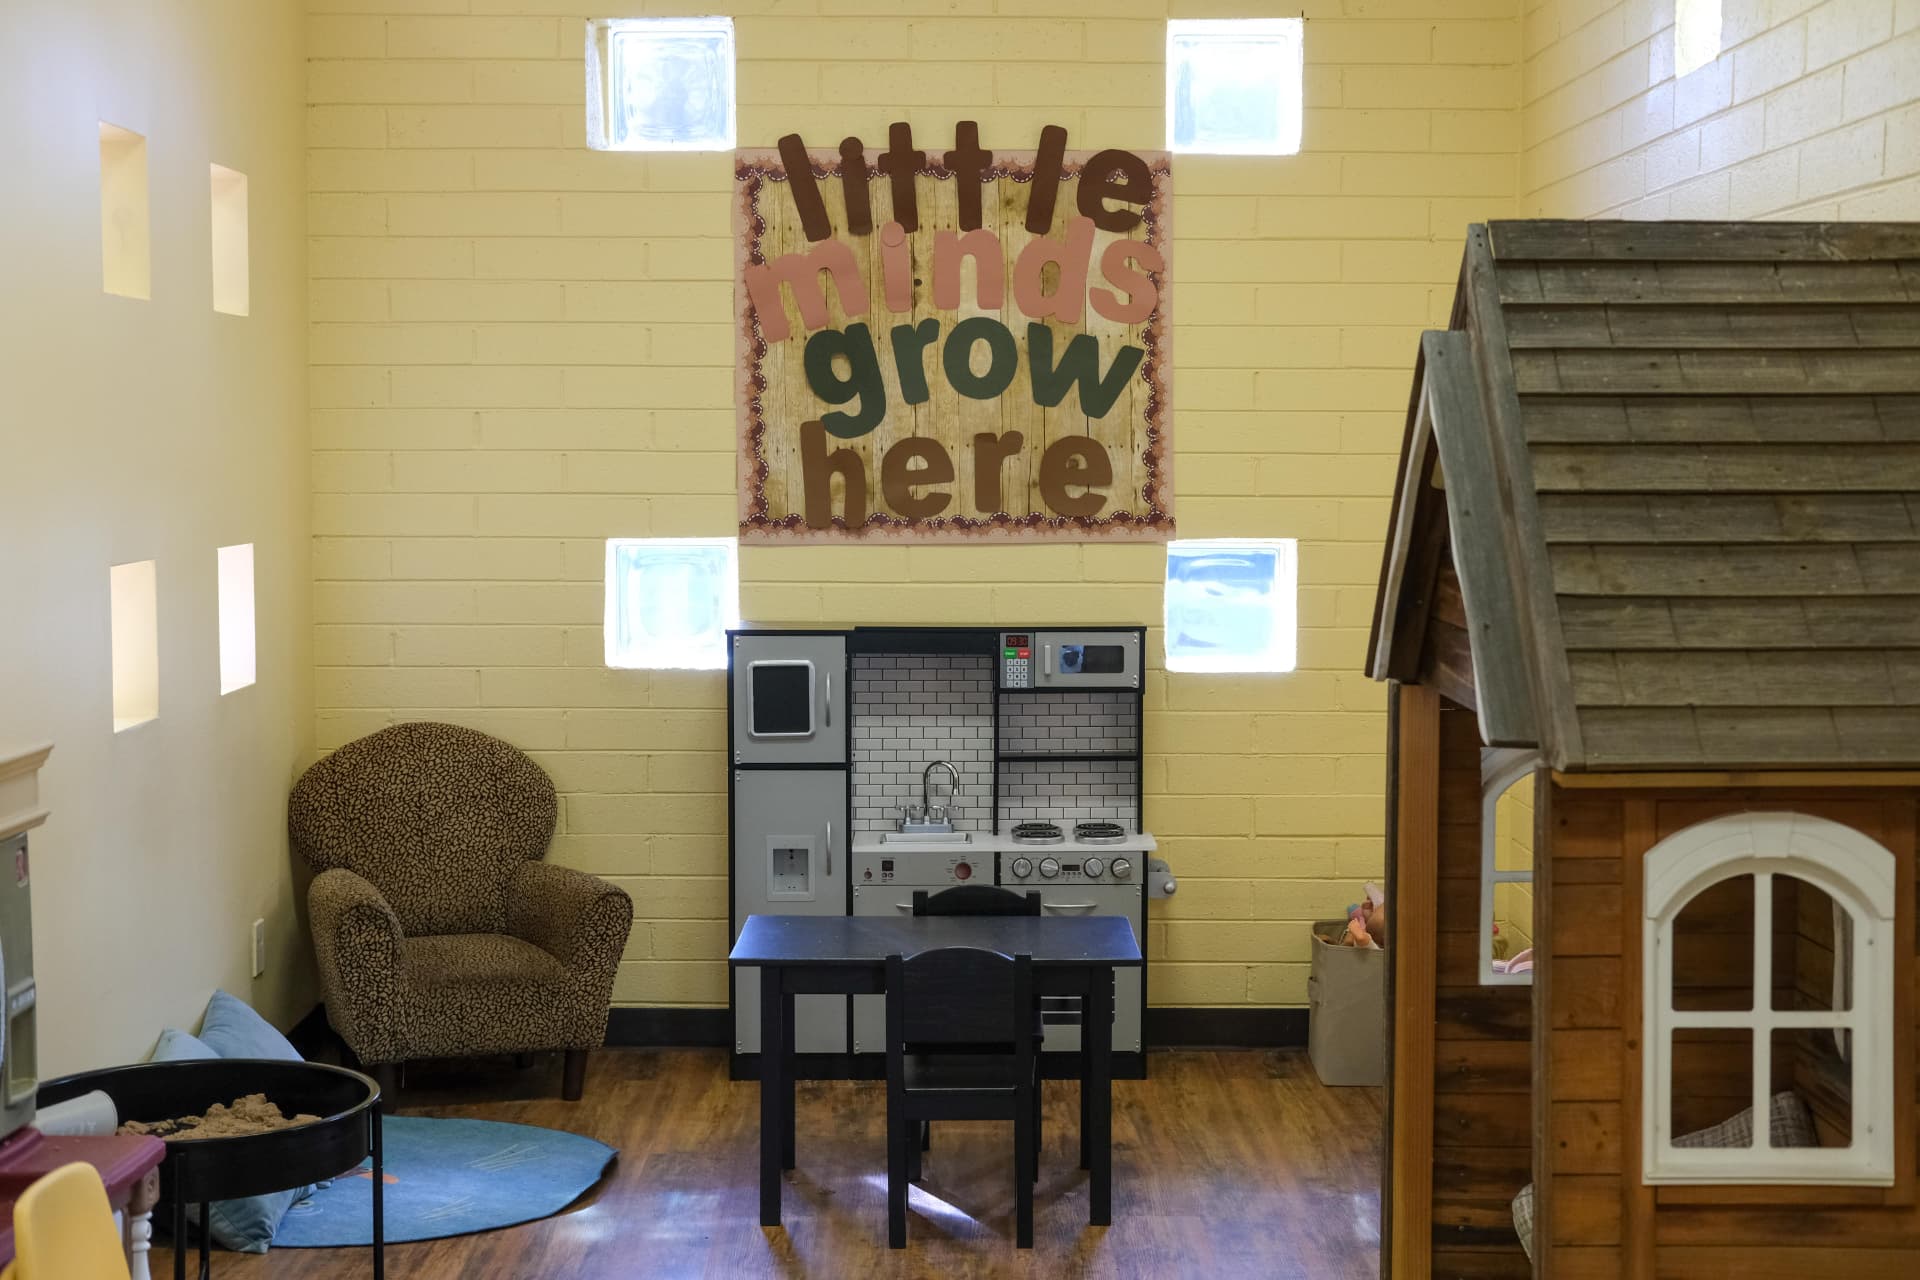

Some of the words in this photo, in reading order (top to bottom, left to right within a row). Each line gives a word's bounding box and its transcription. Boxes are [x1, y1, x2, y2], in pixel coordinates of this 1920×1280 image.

[778, 121, 1154, 242] little
[746, 217, 1165, 343] minds
[803, 317, 1146, 438] grow
[800, 420, 1113, 529] here
